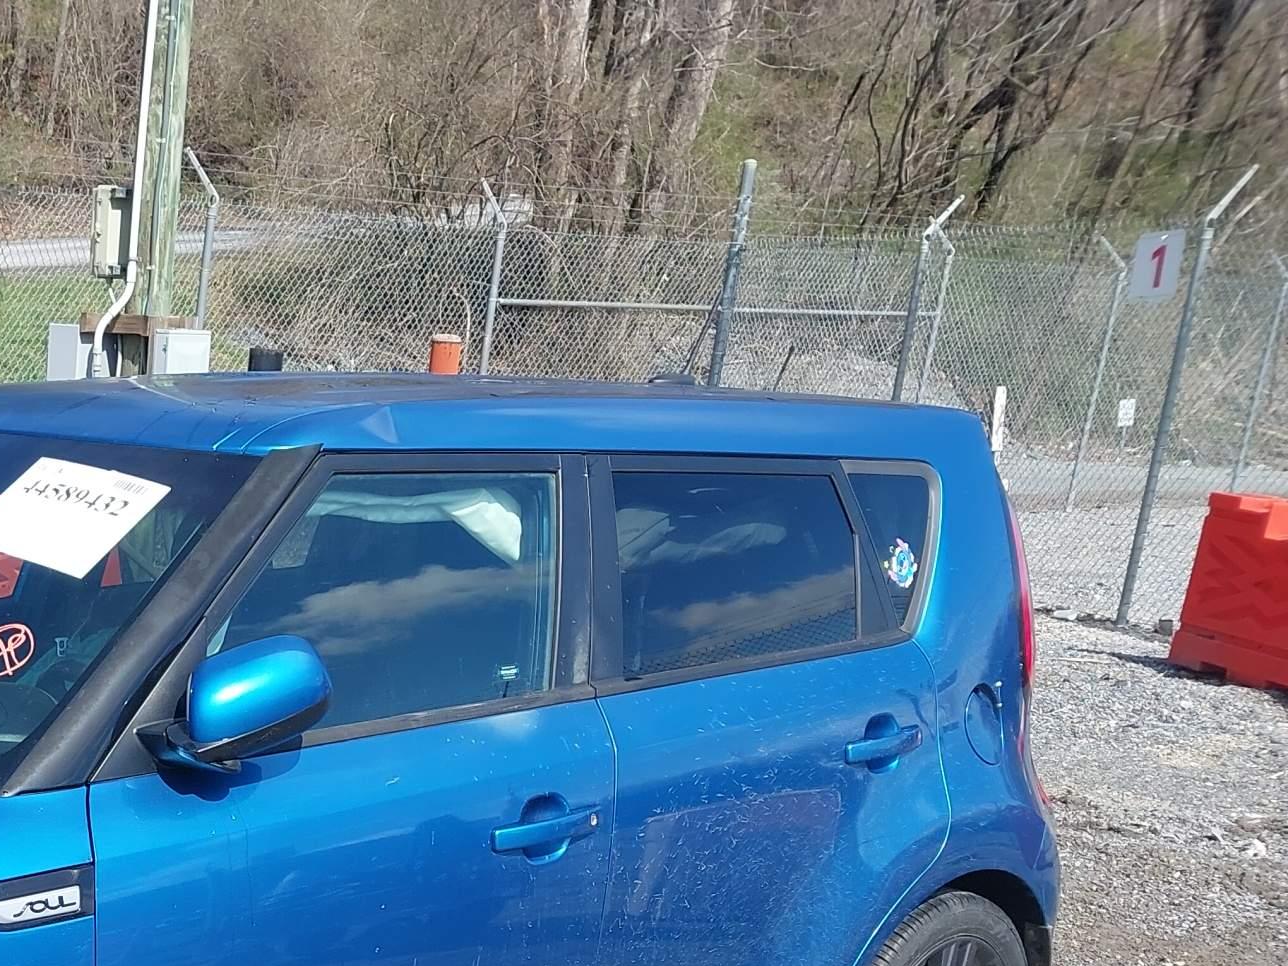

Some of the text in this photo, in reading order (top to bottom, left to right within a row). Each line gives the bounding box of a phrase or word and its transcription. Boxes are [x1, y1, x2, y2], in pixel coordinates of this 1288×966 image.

[1152, 244, 1168, 289] 1
[23, 479, 130, 517] 44589432
[12, 895, 77, 918] SOUL
